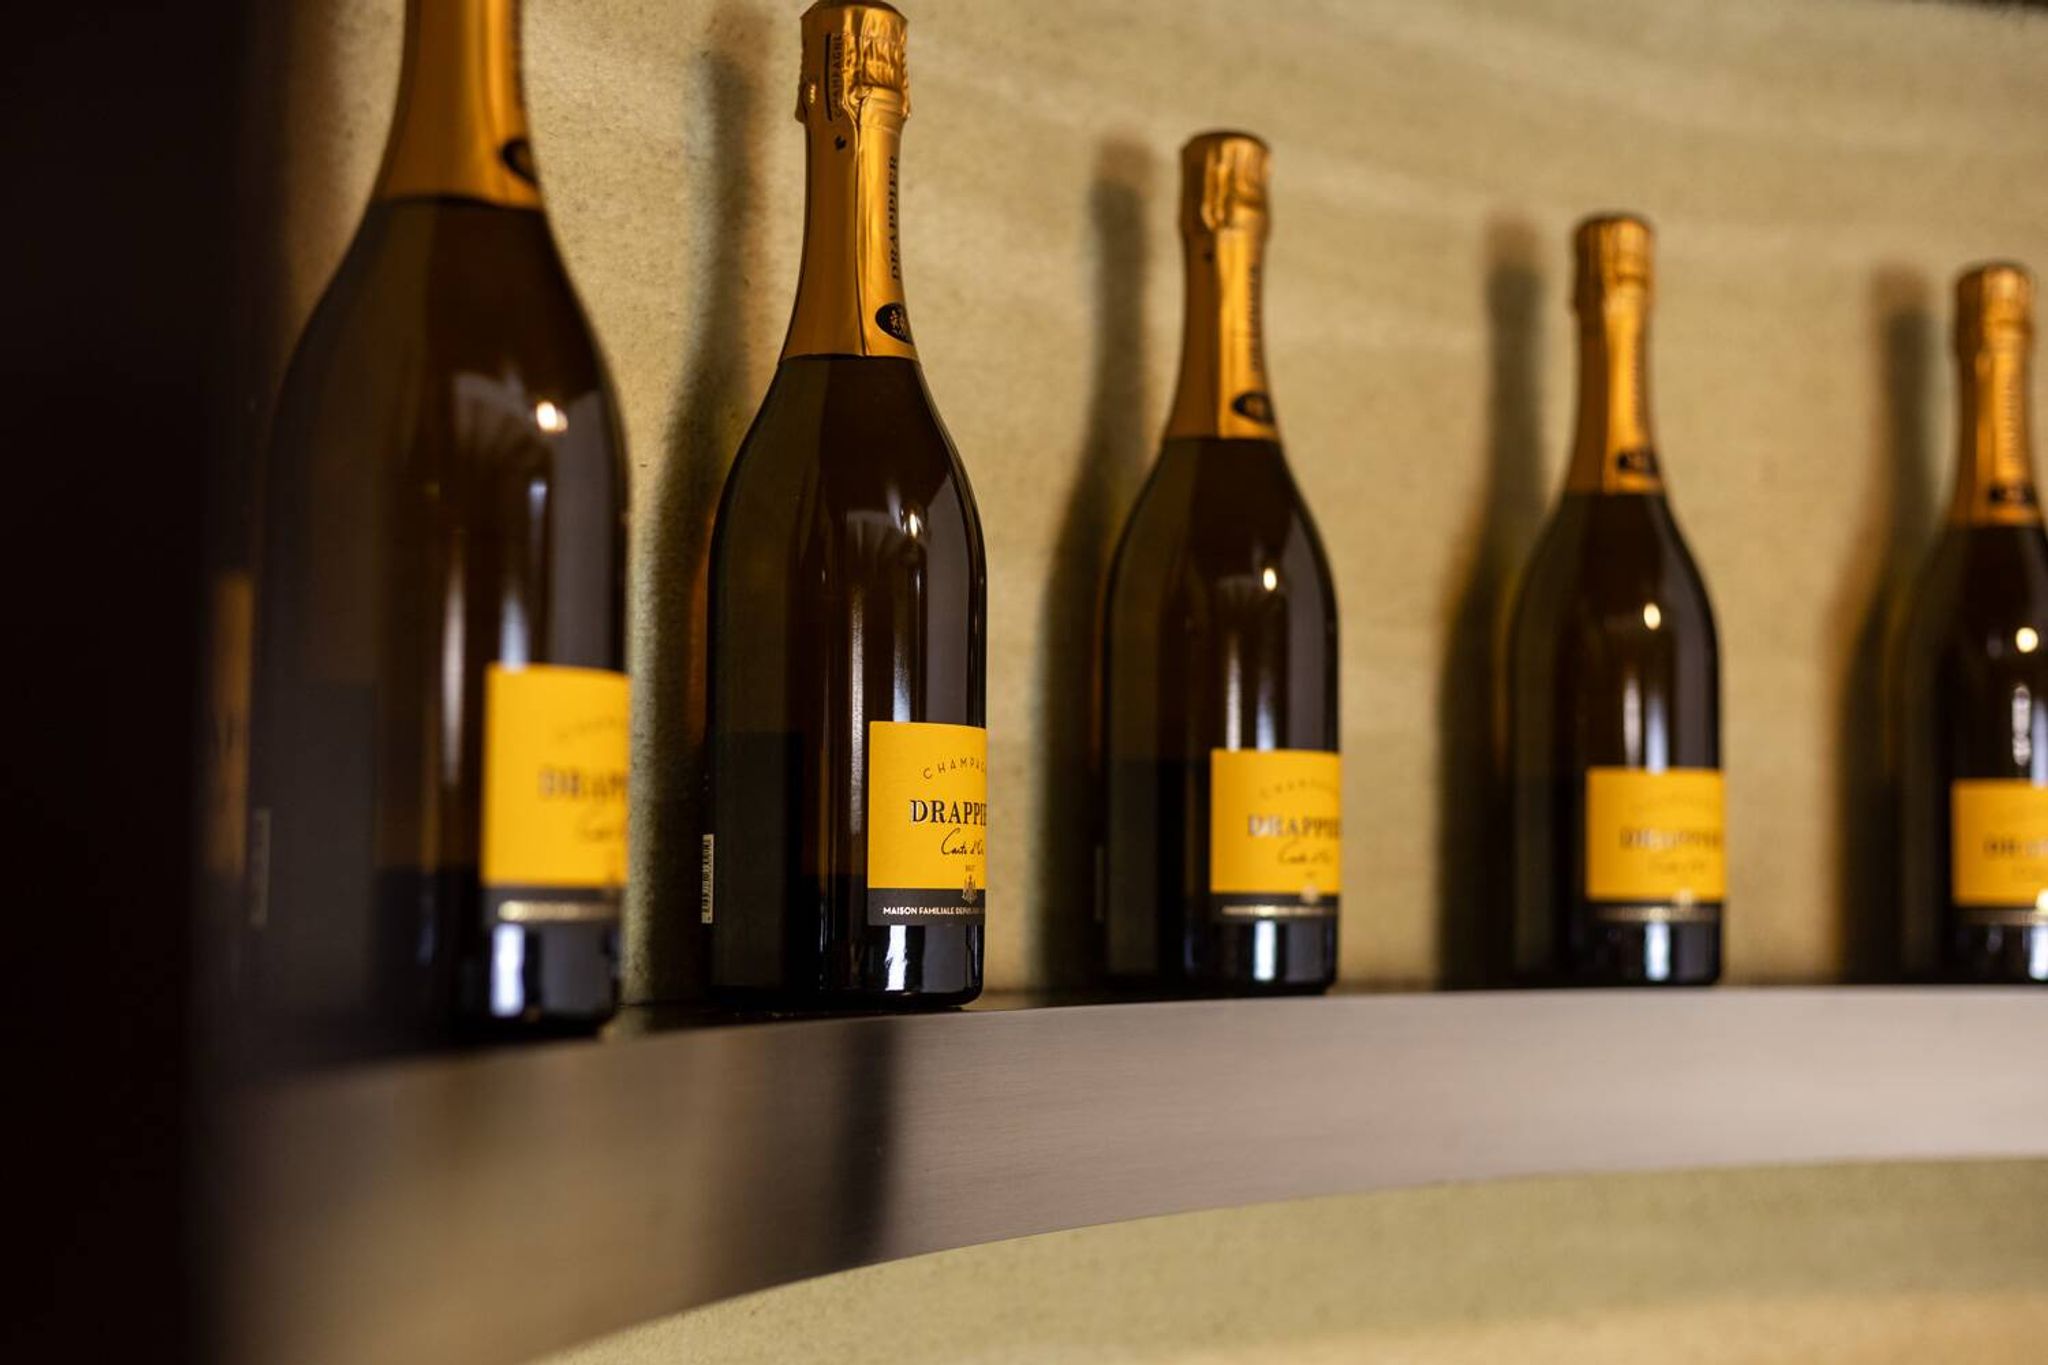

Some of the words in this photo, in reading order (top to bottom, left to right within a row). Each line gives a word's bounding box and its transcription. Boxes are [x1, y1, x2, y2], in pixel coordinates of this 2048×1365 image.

[888, 155, 900, 281] DRAPPIER
[883, 906, 917, 915] MAISON
[919, 906, 954, 915] FAMILIALE
